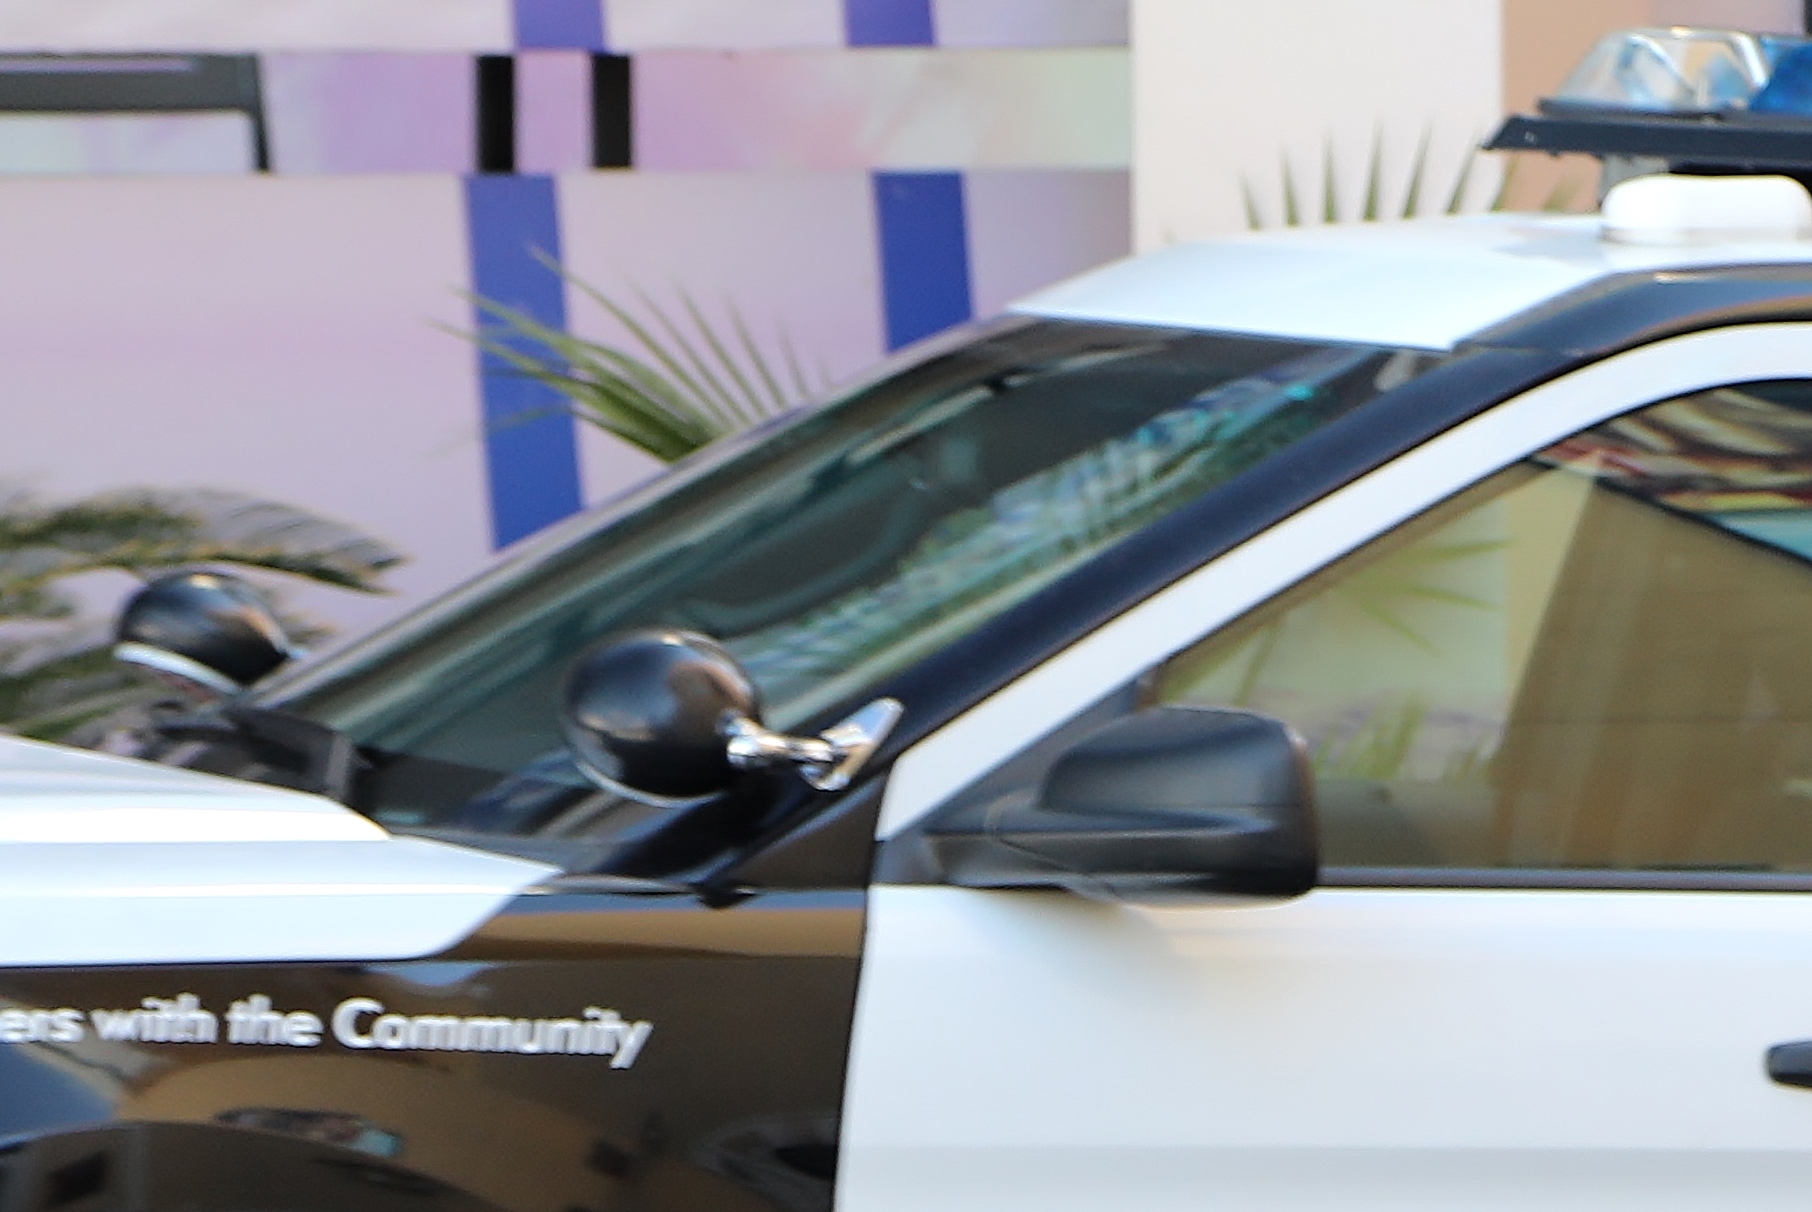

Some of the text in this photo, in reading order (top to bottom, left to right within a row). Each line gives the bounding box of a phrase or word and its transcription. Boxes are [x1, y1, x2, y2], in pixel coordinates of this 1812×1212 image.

[90, 993, 218, 1043] with
[226, 994, 323, 1046] the
[331, 997, 653, 1069] Community
